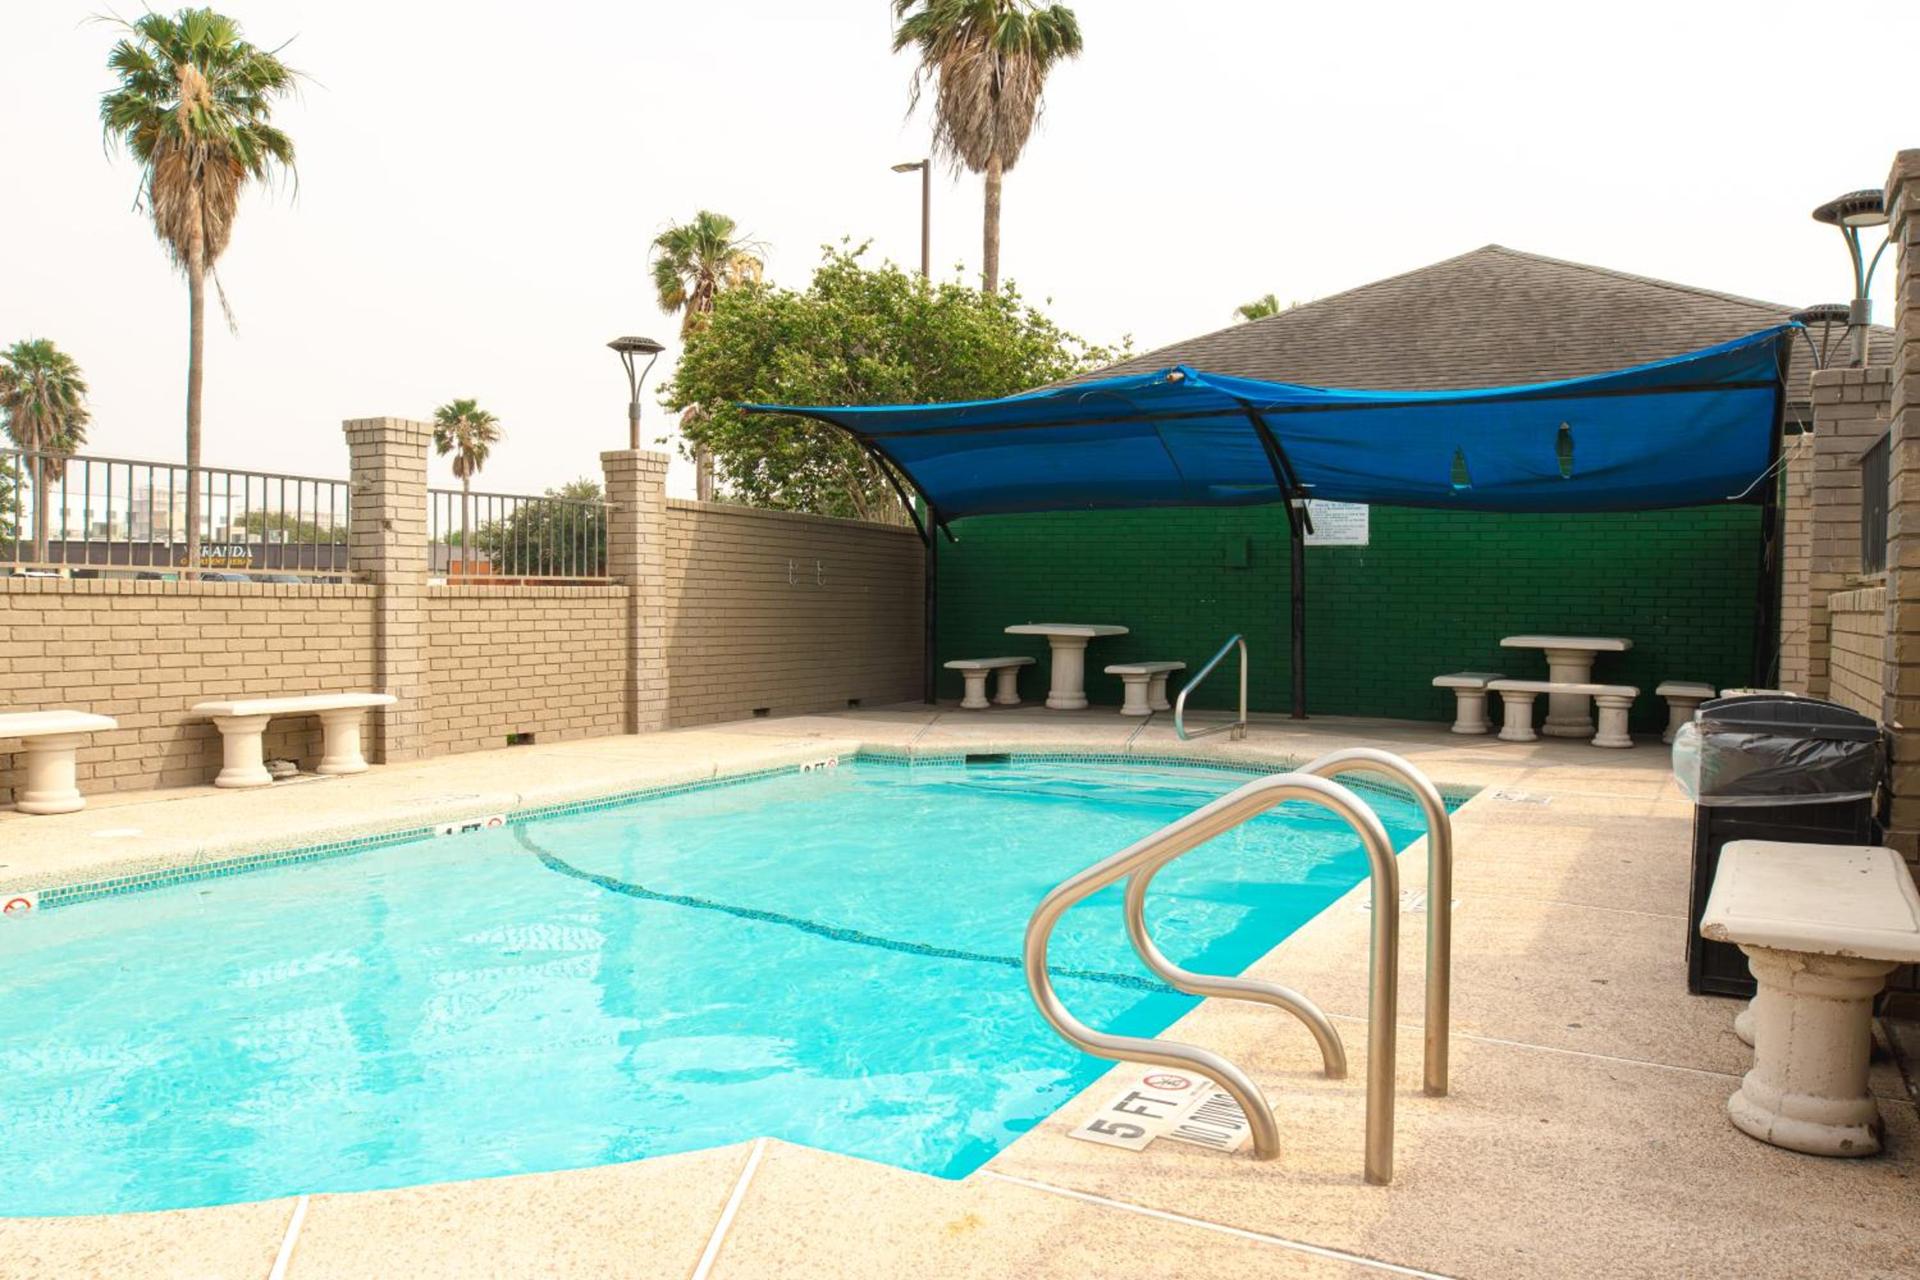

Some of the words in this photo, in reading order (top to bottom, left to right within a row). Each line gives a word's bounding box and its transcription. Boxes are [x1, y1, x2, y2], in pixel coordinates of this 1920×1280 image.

[183, 545, 253, 558] RANDA
[1112, 1090, 1178, 1119] FT
[1086, 1118, 1146, 1139] 5
[1169, 1124, 1233, 1148] NO
